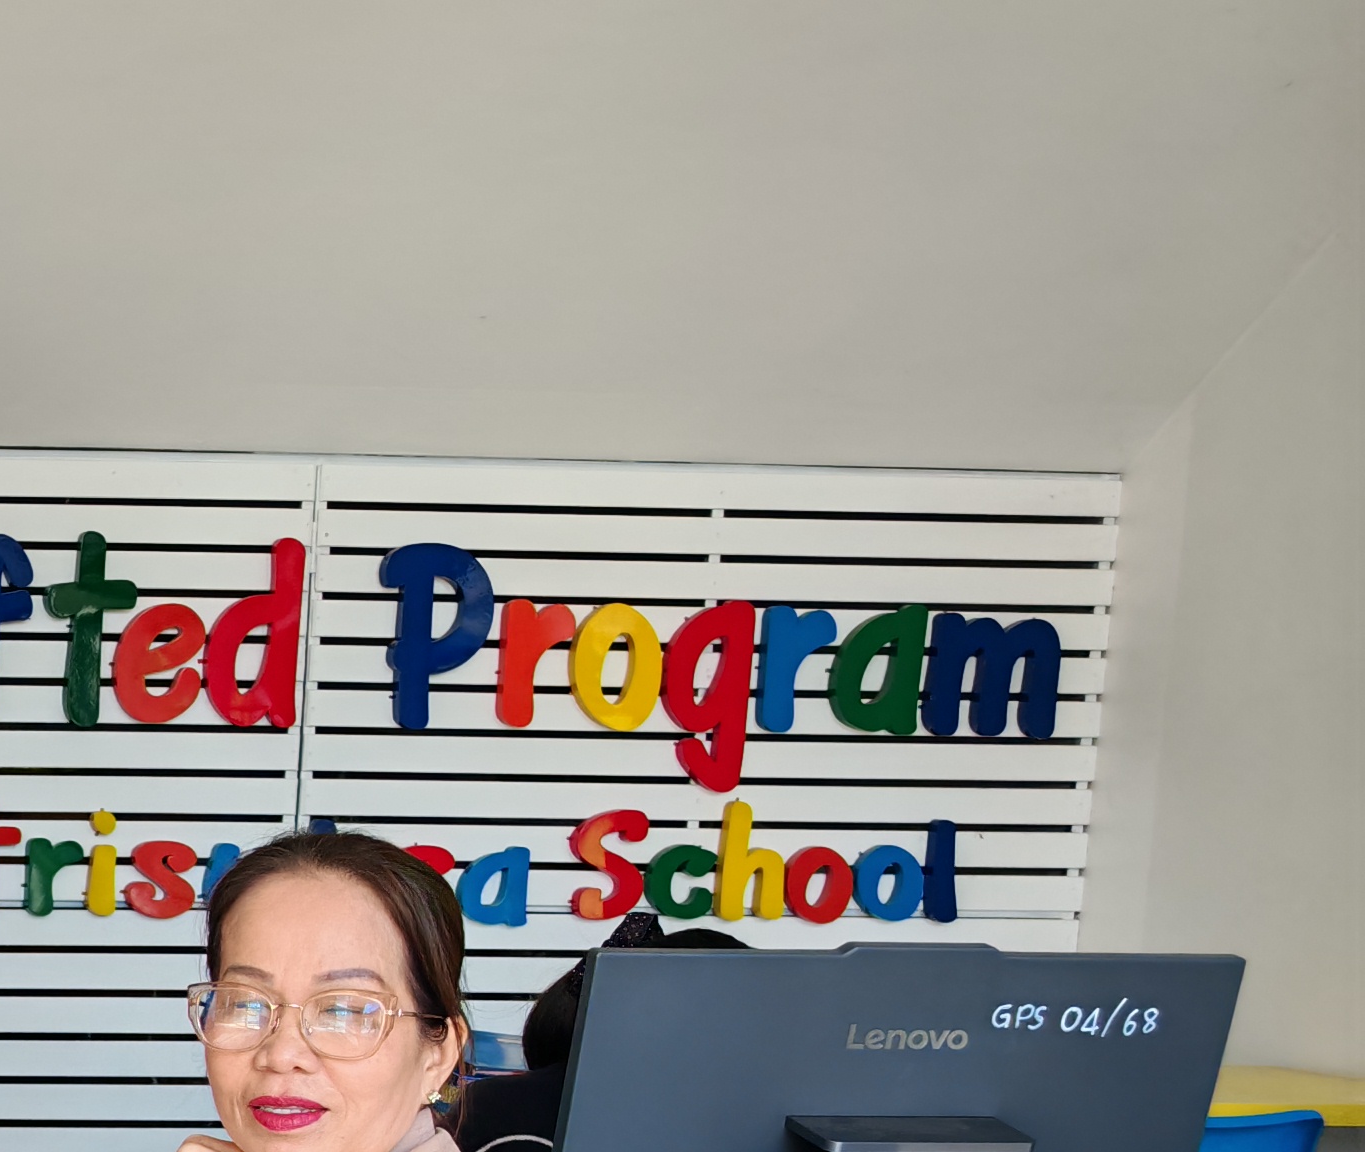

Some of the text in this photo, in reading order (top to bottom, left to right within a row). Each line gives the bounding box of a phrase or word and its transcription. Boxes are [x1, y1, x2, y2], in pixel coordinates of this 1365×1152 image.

[379, 541, 1062, 794] Program
[569, 799, 958, 924] School
[845, 1023, 969, 1050] Lenovo
[990, 997, 1161, 1038] GPS 04/68
